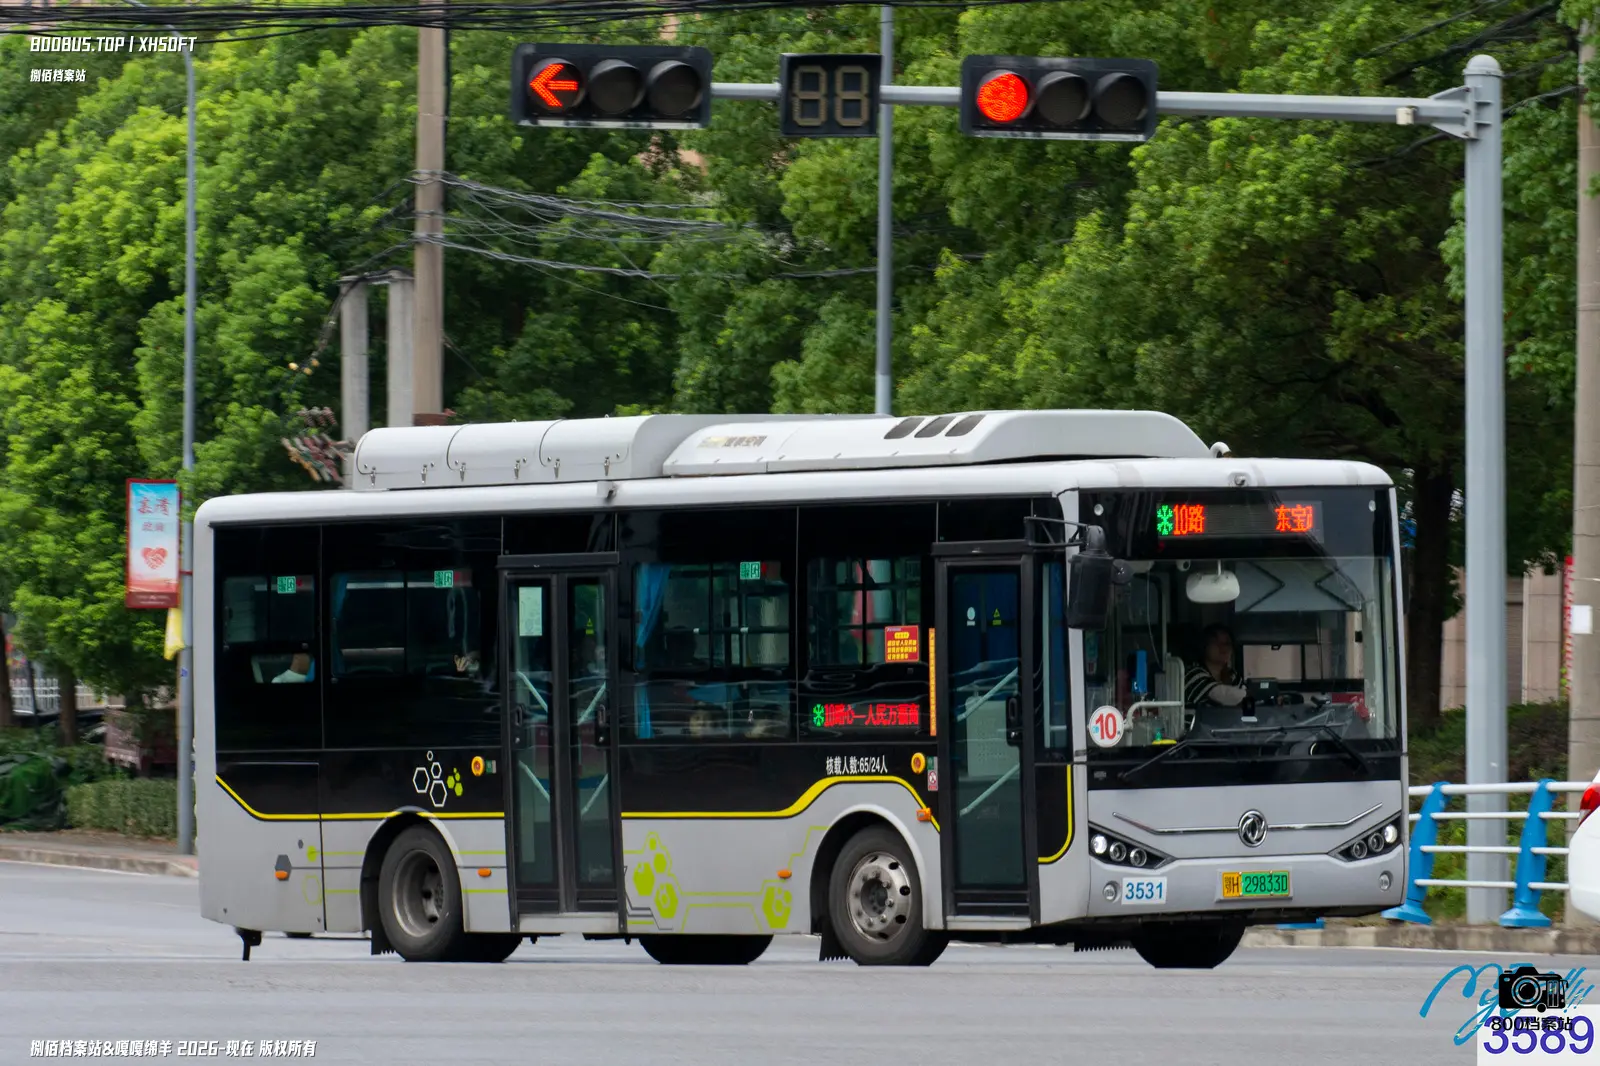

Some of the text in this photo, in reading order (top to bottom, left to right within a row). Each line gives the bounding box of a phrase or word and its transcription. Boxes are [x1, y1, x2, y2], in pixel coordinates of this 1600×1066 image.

[1173, 504, 1204, 536] 10路
[1095, 712, 1117, 740] 10
[825, 755, 888, 775] 核载人数:65/24人
[1125, 882, 1164, 900] 3531
